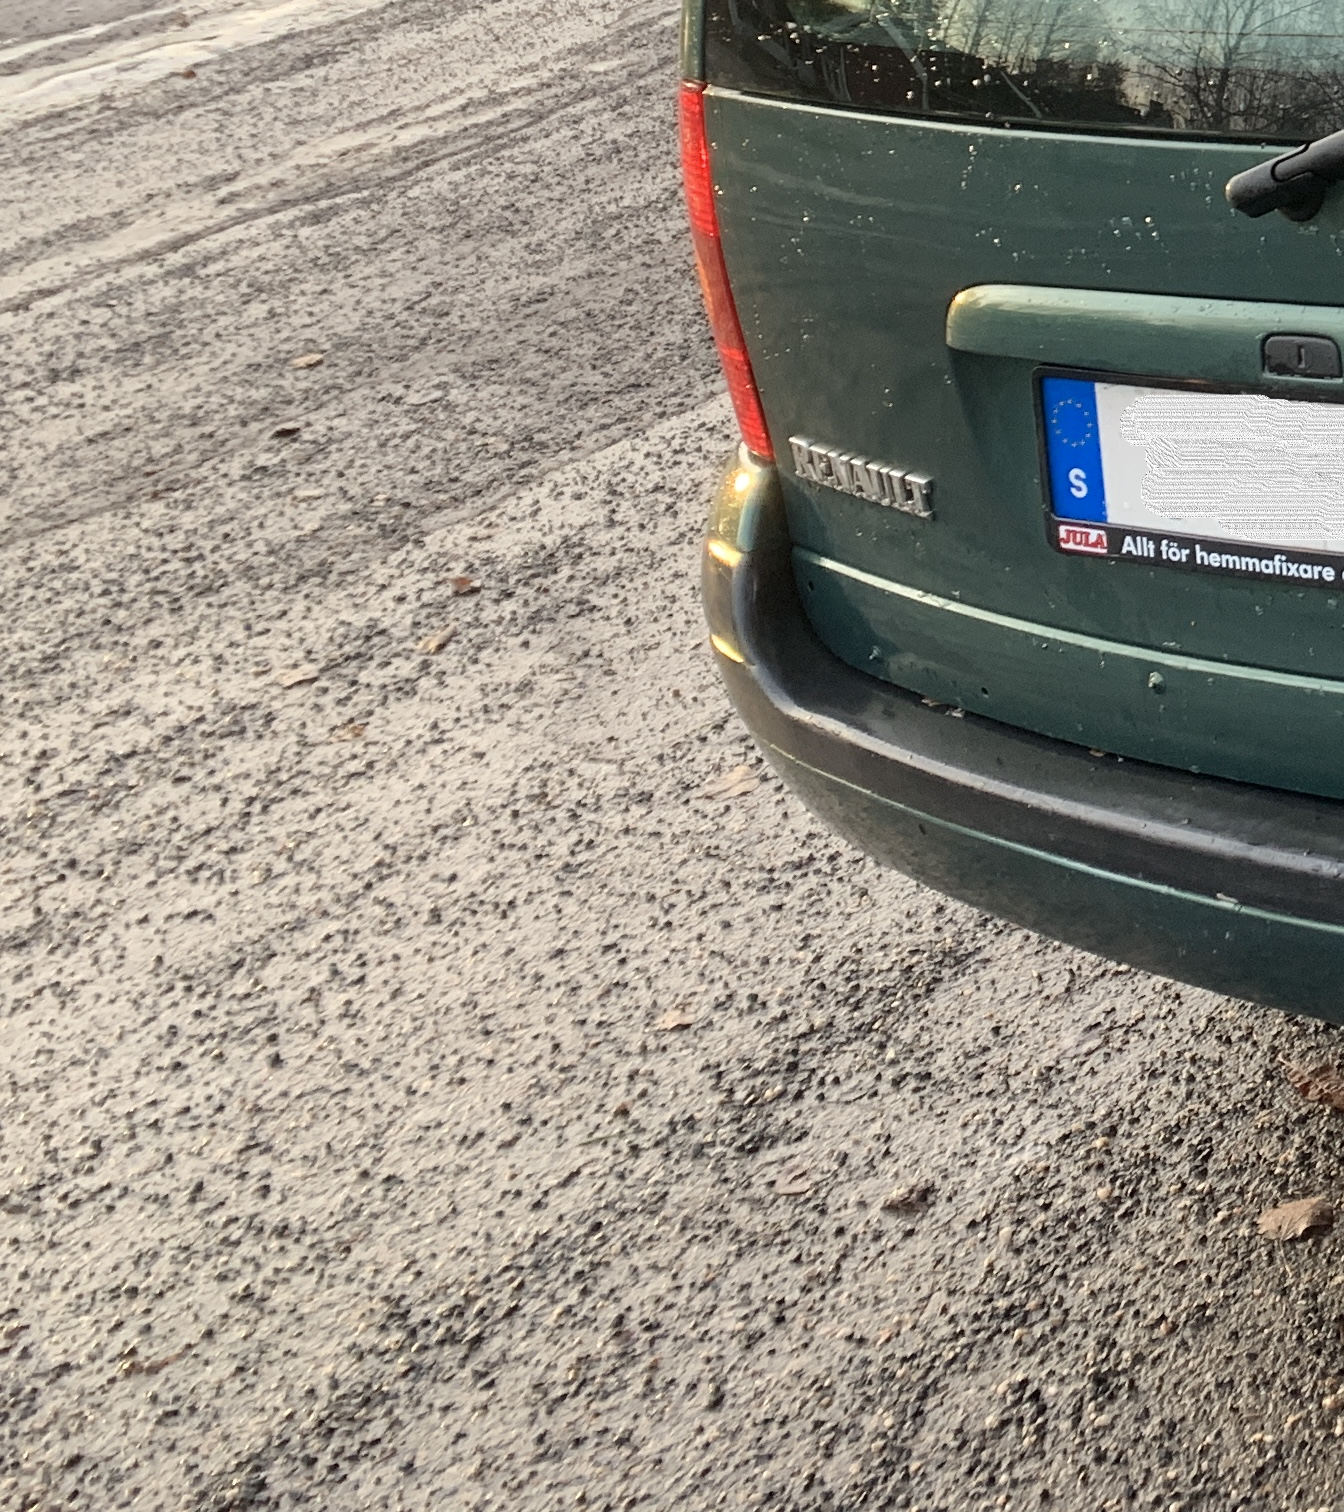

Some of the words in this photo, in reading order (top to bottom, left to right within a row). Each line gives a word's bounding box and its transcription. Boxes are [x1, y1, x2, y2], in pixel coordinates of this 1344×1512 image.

[1068, 467, 1089, 499] S
[1060, 529, 1106, 549] JULA
[1121, 535, 1156, 558] Allt
[1160, 539, 1190, 562] för
[1194, 544, 1336, 582] hemmafixare
